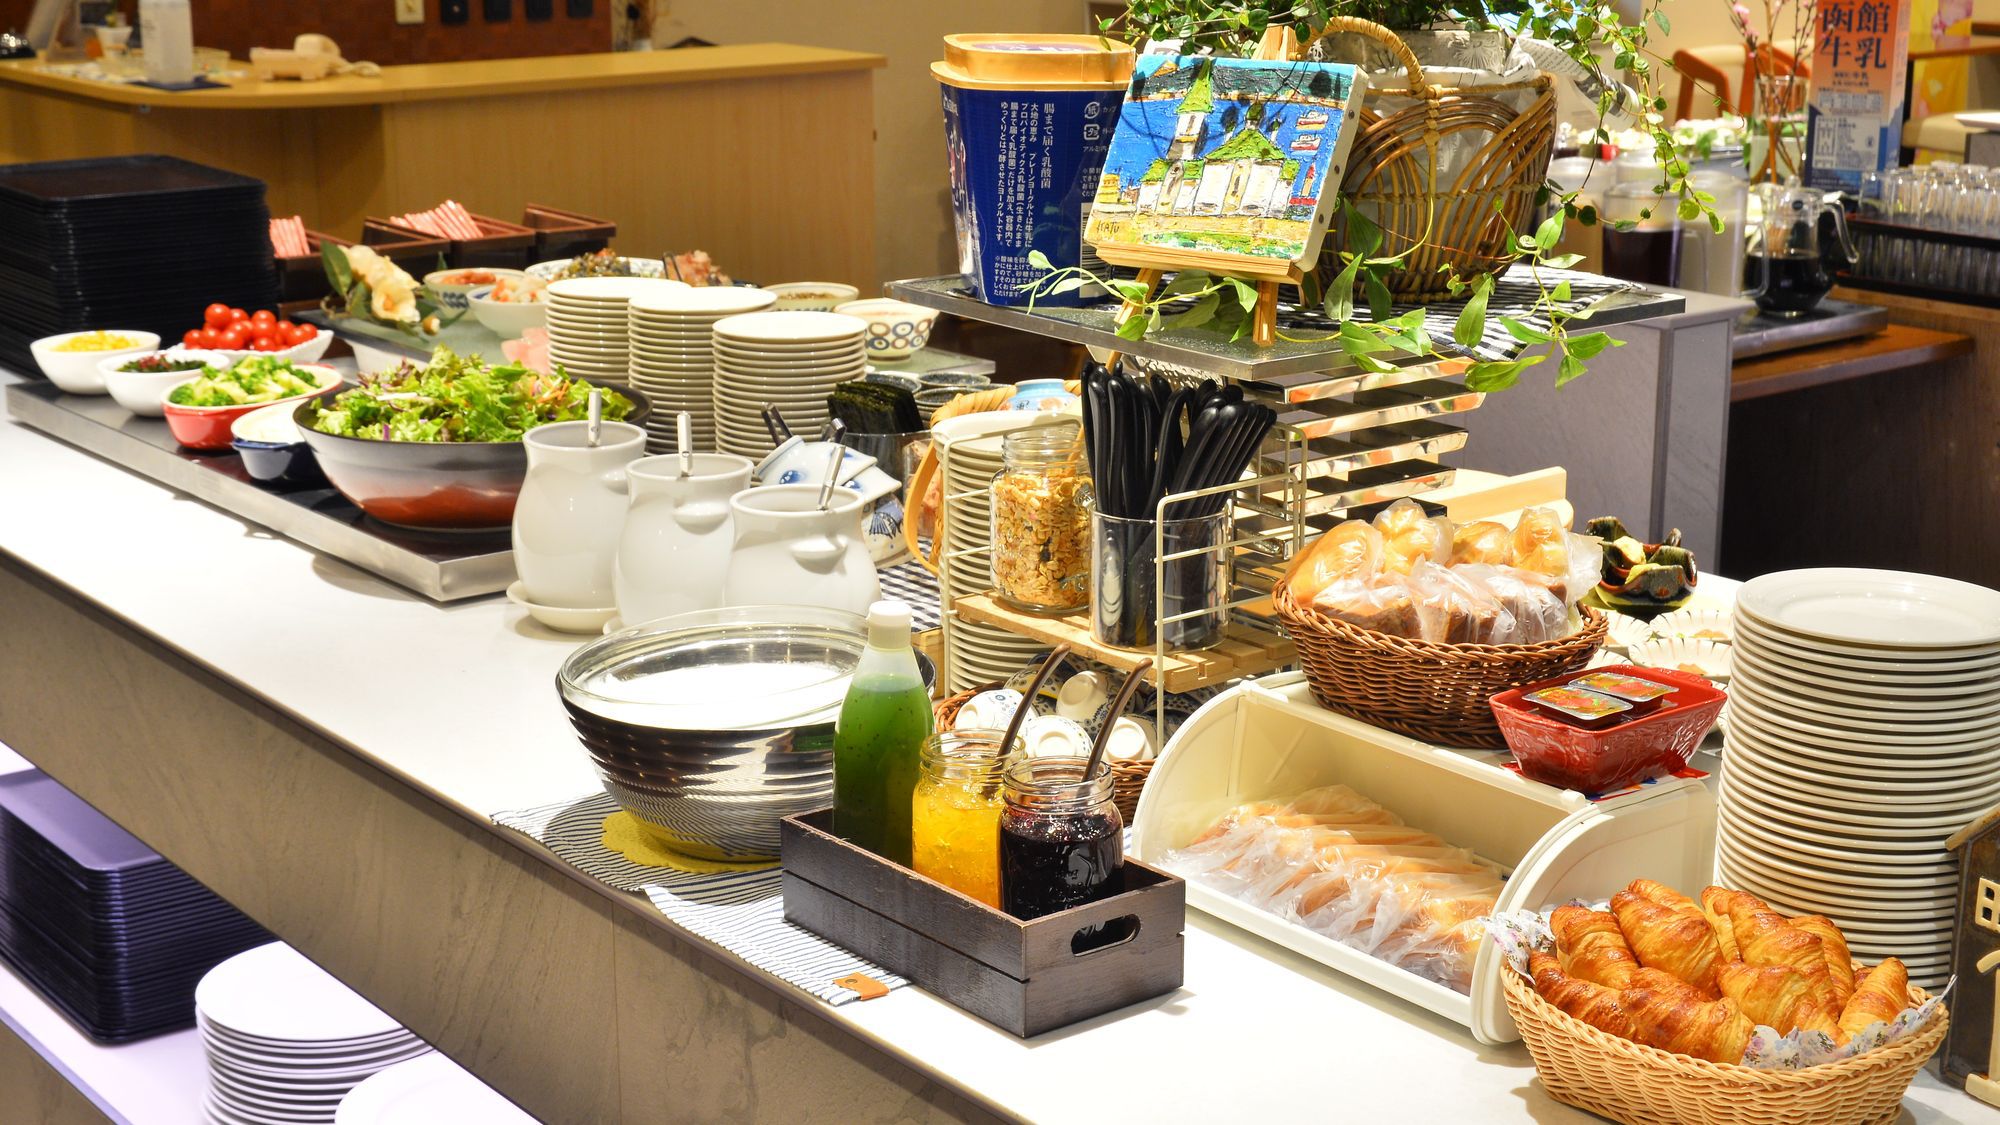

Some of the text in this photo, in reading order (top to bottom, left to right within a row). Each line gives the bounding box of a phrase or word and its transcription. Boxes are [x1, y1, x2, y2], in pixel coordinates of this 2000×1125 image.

[1822, 1, 1889, 33] 函館
[1821, 36, 1887, 68] 牛乳
[1029, 102, 1039, 142] 大地の恵み
[1041, 102, 1055, 189] 腸まで届く乳酸菌
